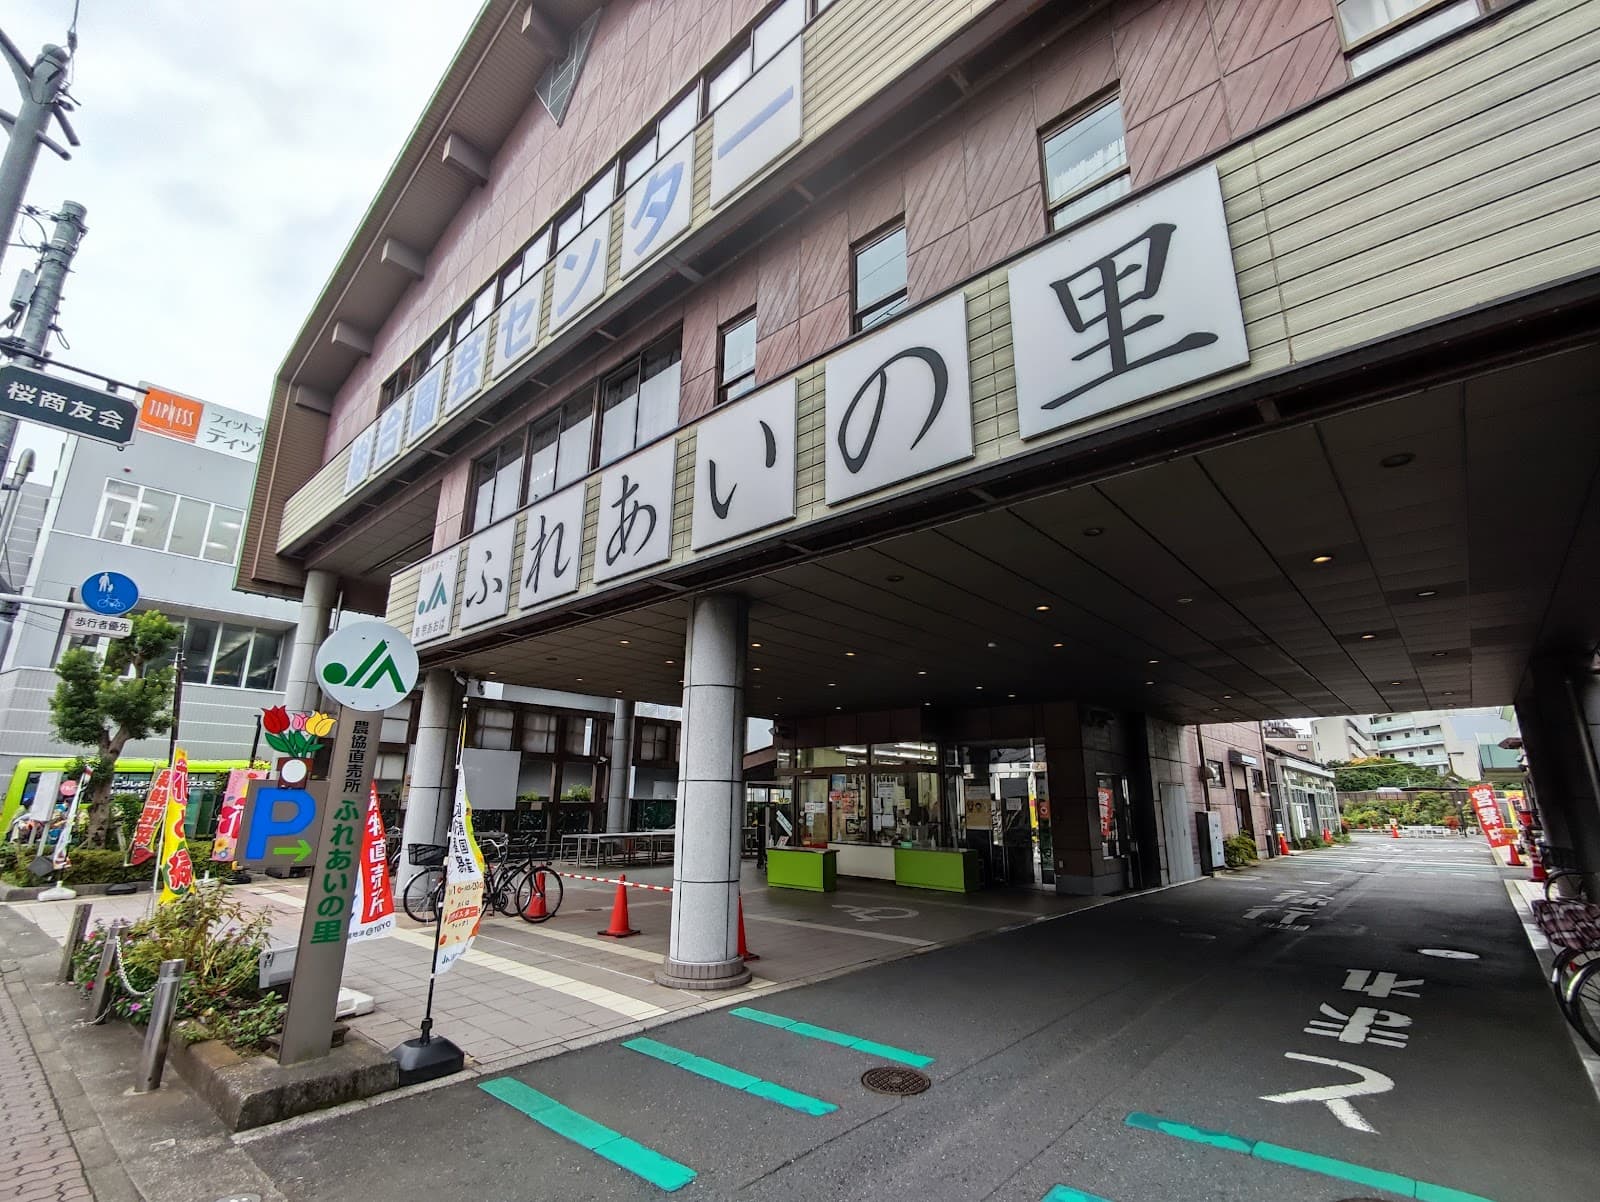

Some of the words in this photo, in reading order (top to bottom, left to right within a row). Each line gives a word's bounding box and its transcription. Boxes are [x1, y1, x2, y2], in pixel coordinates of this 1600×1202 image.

[7, 380, 125, 431] 桜商友会
[148, 397, 196, 428] TIPNESS
[464, 221, 1220, 608] ふれあいの里
[206, 430, 260, 454] ティッ
[74, 615, 130, 633] 歩行者優先
[343, 719, 371, 793] 農協直売所
[245, 786, 316, 860] P
[1472, 788, 1504, 843] 営業中
[310, 799, 360, 945] ふれあいの里
